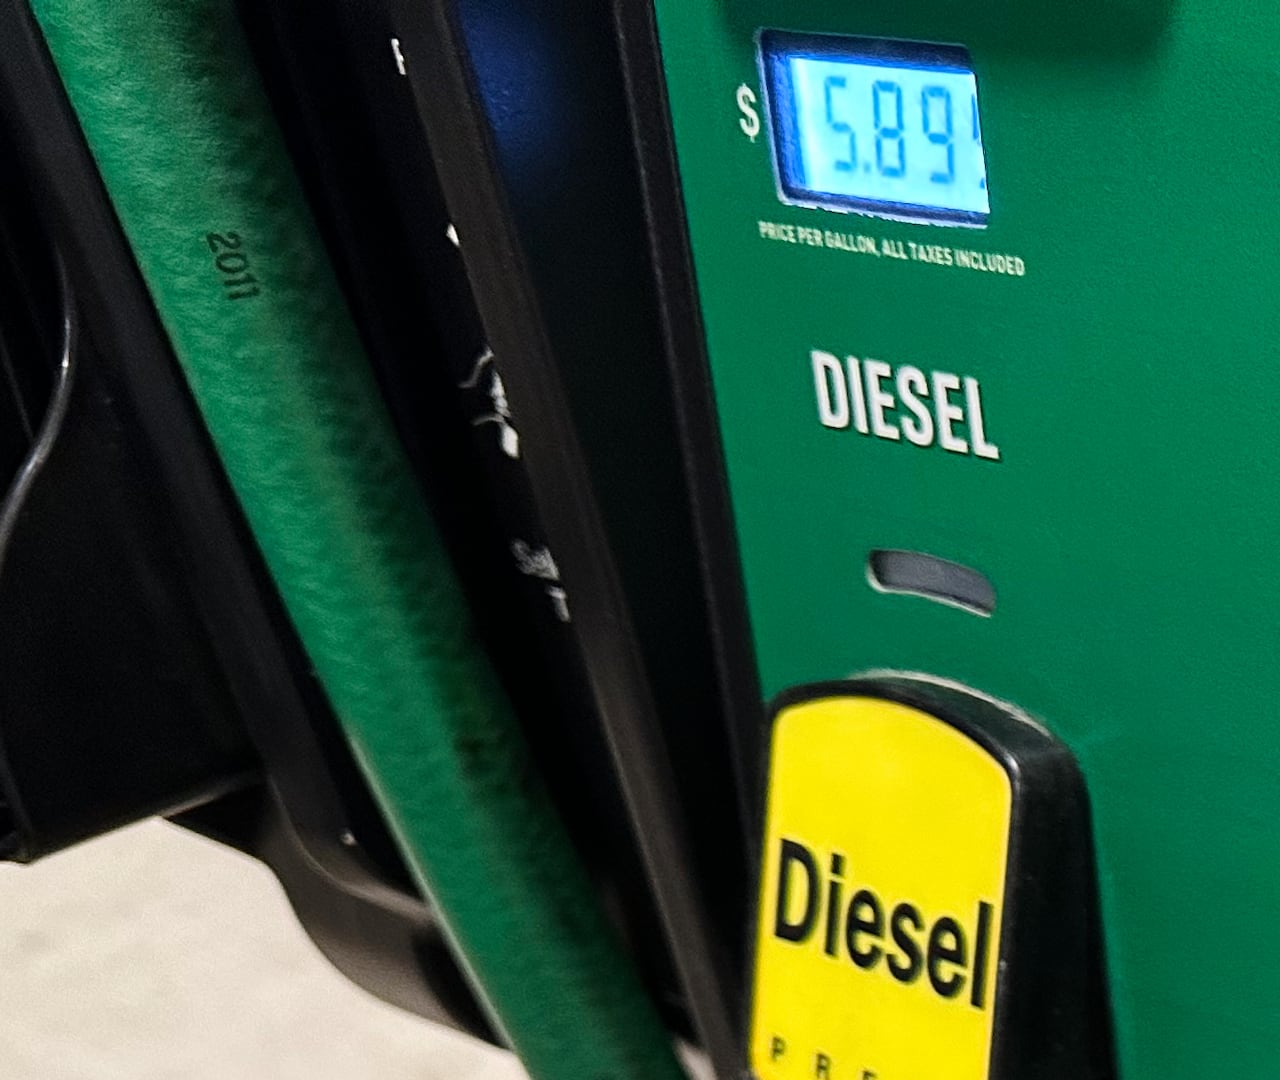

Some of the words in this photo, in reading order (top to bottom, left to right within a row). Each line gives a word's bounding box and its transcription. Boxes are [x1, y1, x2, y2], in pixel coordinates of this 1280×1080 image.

[736, 83, 760, 142] $
[823, 75, 986, 190] 5.89
[757, 220, 797, 244] PRICE
[796, 226, 824, 247] PER
[825, 230, 881, 258] GALLON,
[881, 238, 909, 260] ALL
[908, 241, 954, 266] TAXES
[953, 248, 1026, 277] INCLUDED
[810, 349, 1000, 460] DIESEL
[773, 837, 994, 1011] Diesel
